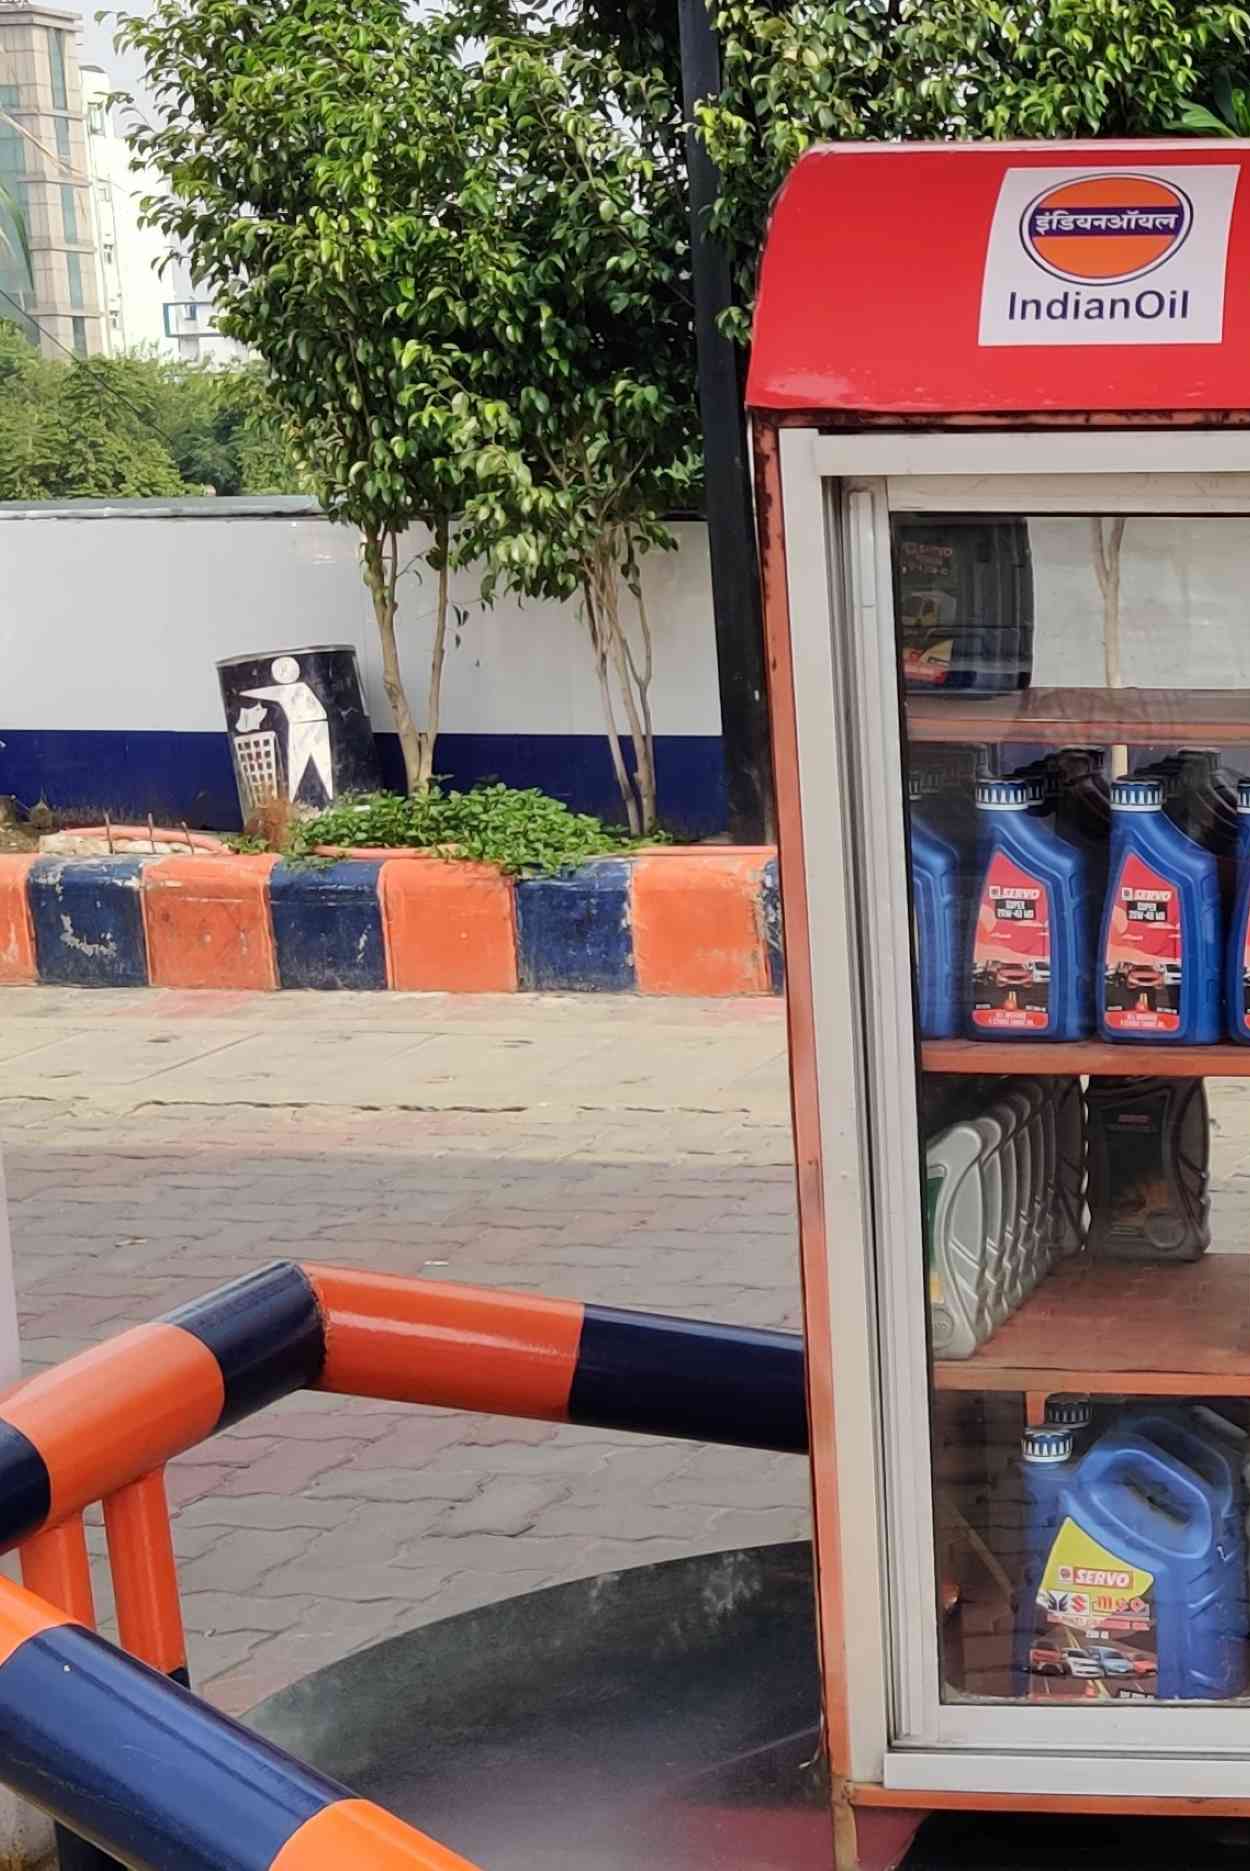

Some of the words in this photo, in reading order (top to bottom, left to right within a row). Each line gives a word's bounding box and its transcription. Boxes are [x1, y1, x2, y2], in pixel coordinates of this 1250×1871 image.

[1035, 210, 1178, 235] इंडियनऑयल
[1008, 290, 1189, 320] IndianOil
[1001, 887, 1040, 899] SERVO
[1134, 888, 1172, 901] SERVO
[1075, 1570, 1130, 1587] SERVO
